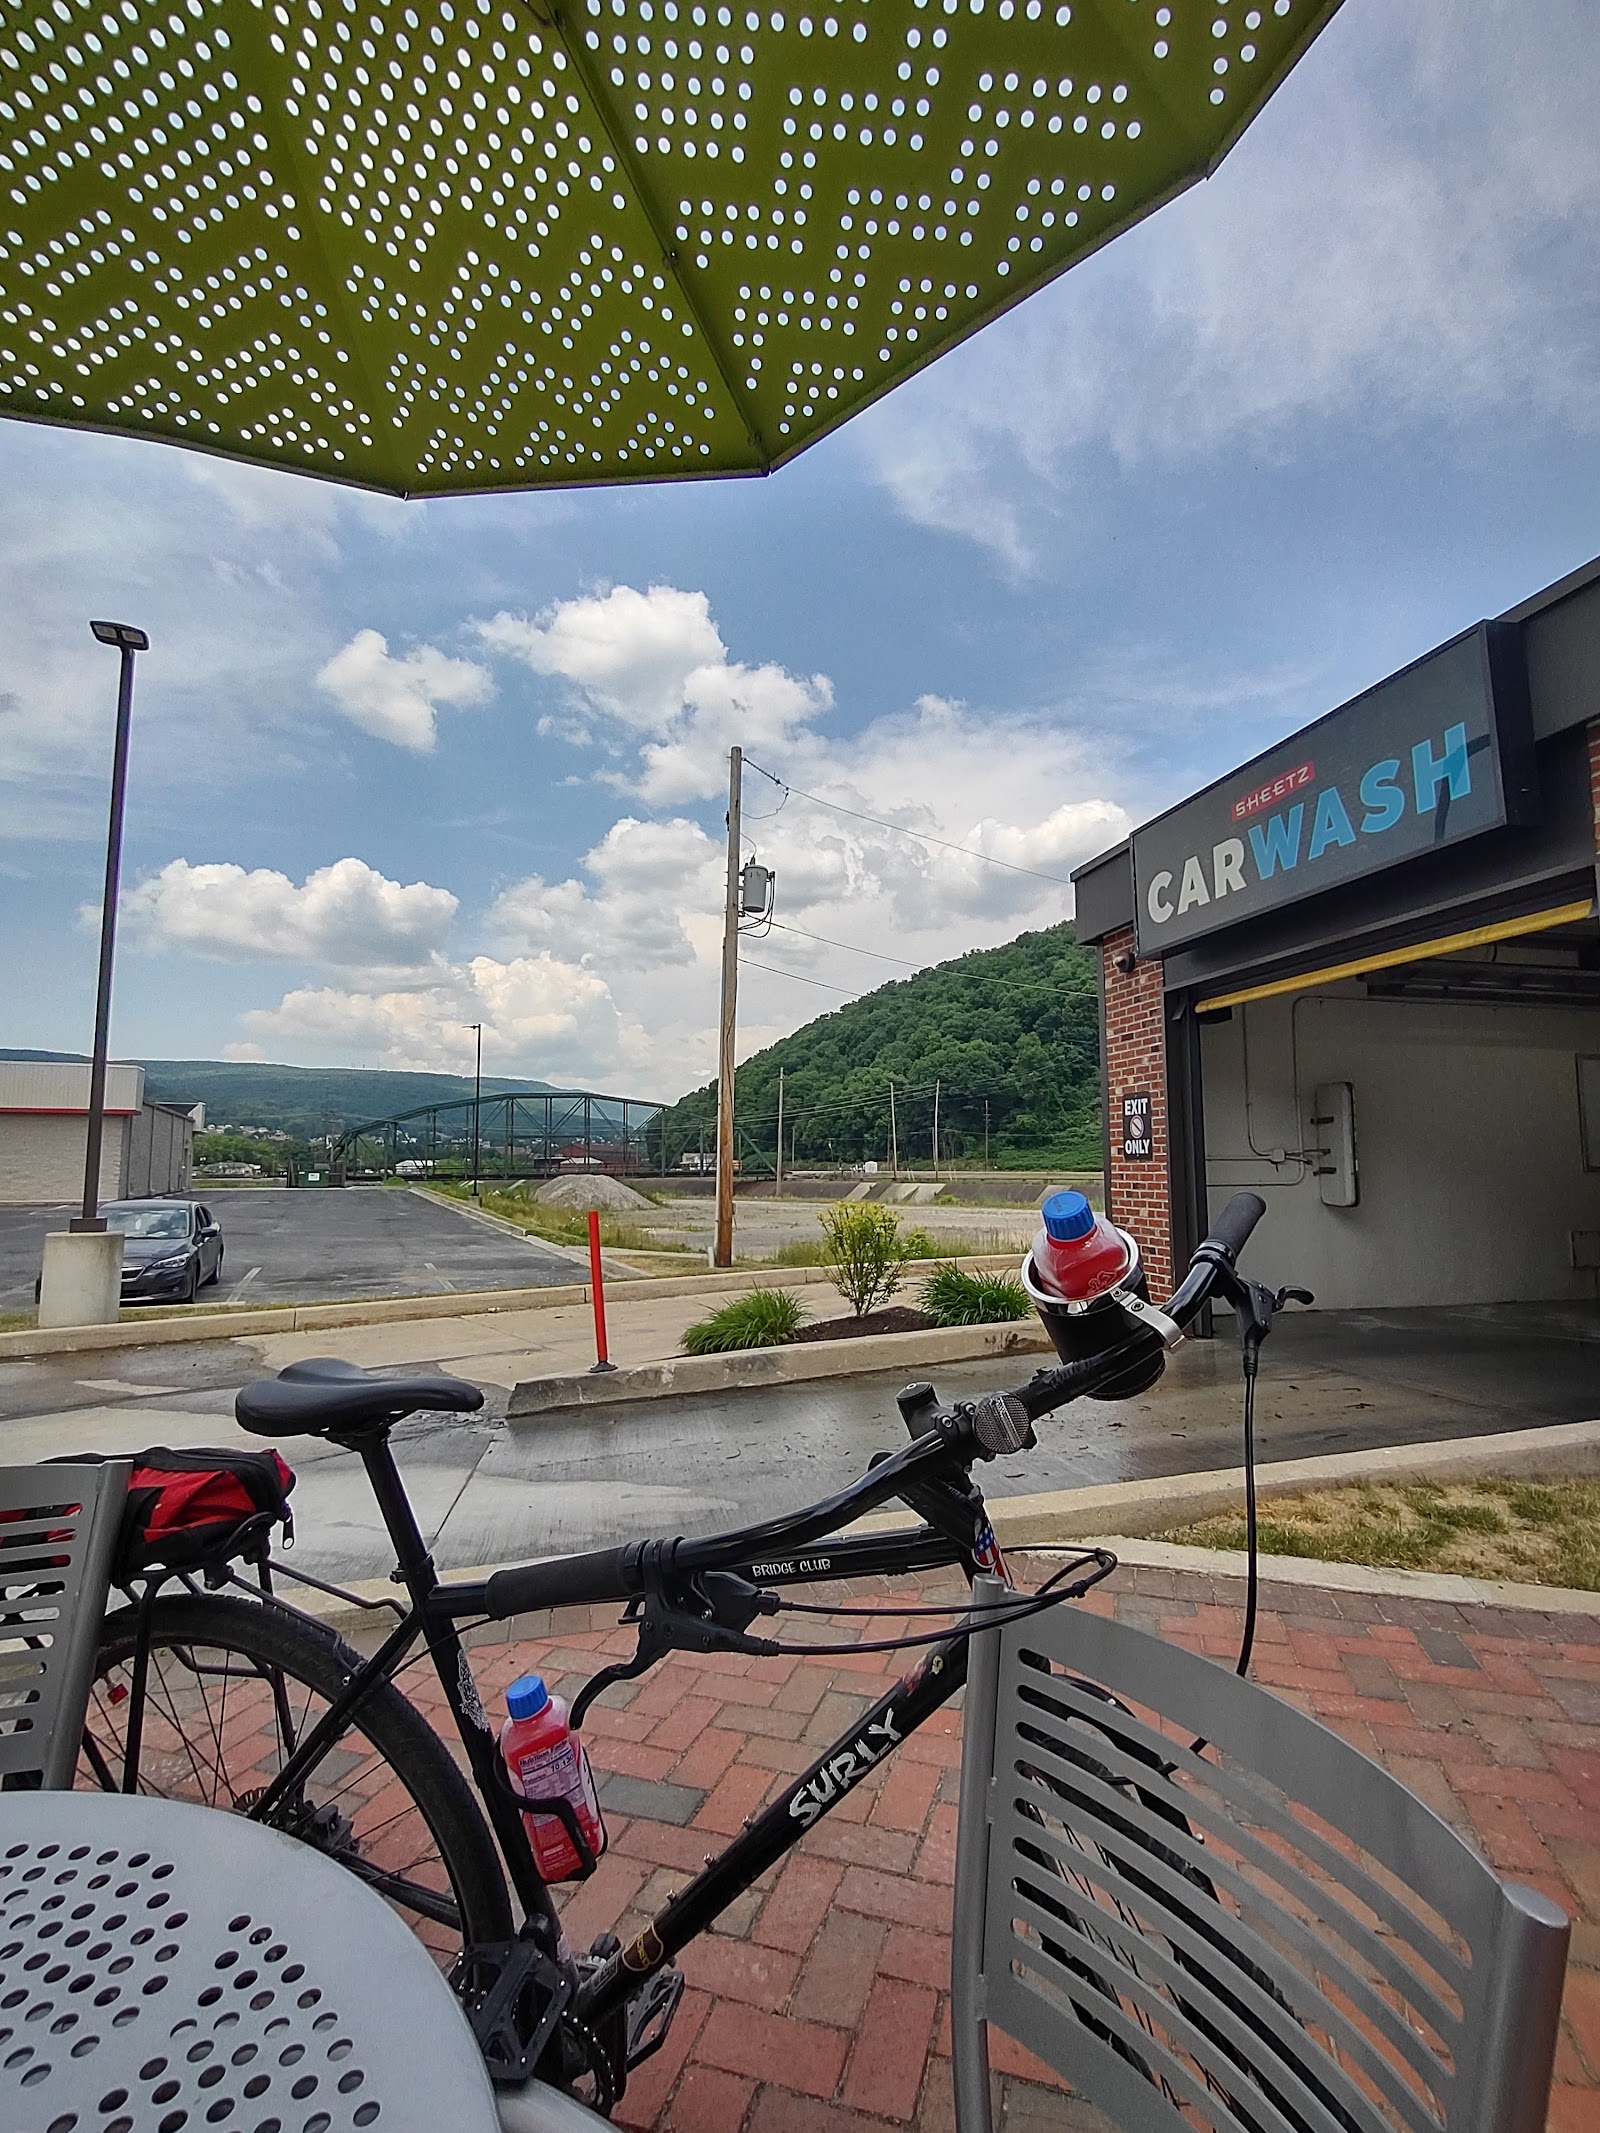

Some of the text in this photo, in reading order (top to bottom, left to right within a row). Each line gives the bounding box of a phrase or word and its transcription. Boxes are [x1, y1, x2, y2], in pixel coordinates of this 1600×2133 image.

[1235, 765, 1310, 816] SHEETZ
[1124, 1098, 1148, 1116] EXIT
[1125, 1139, 1150, 1154] ONLY
[752, 1558, 831, 1577] BRIDGE CLUB
[789, 1708, 901, 1827] SURLY
